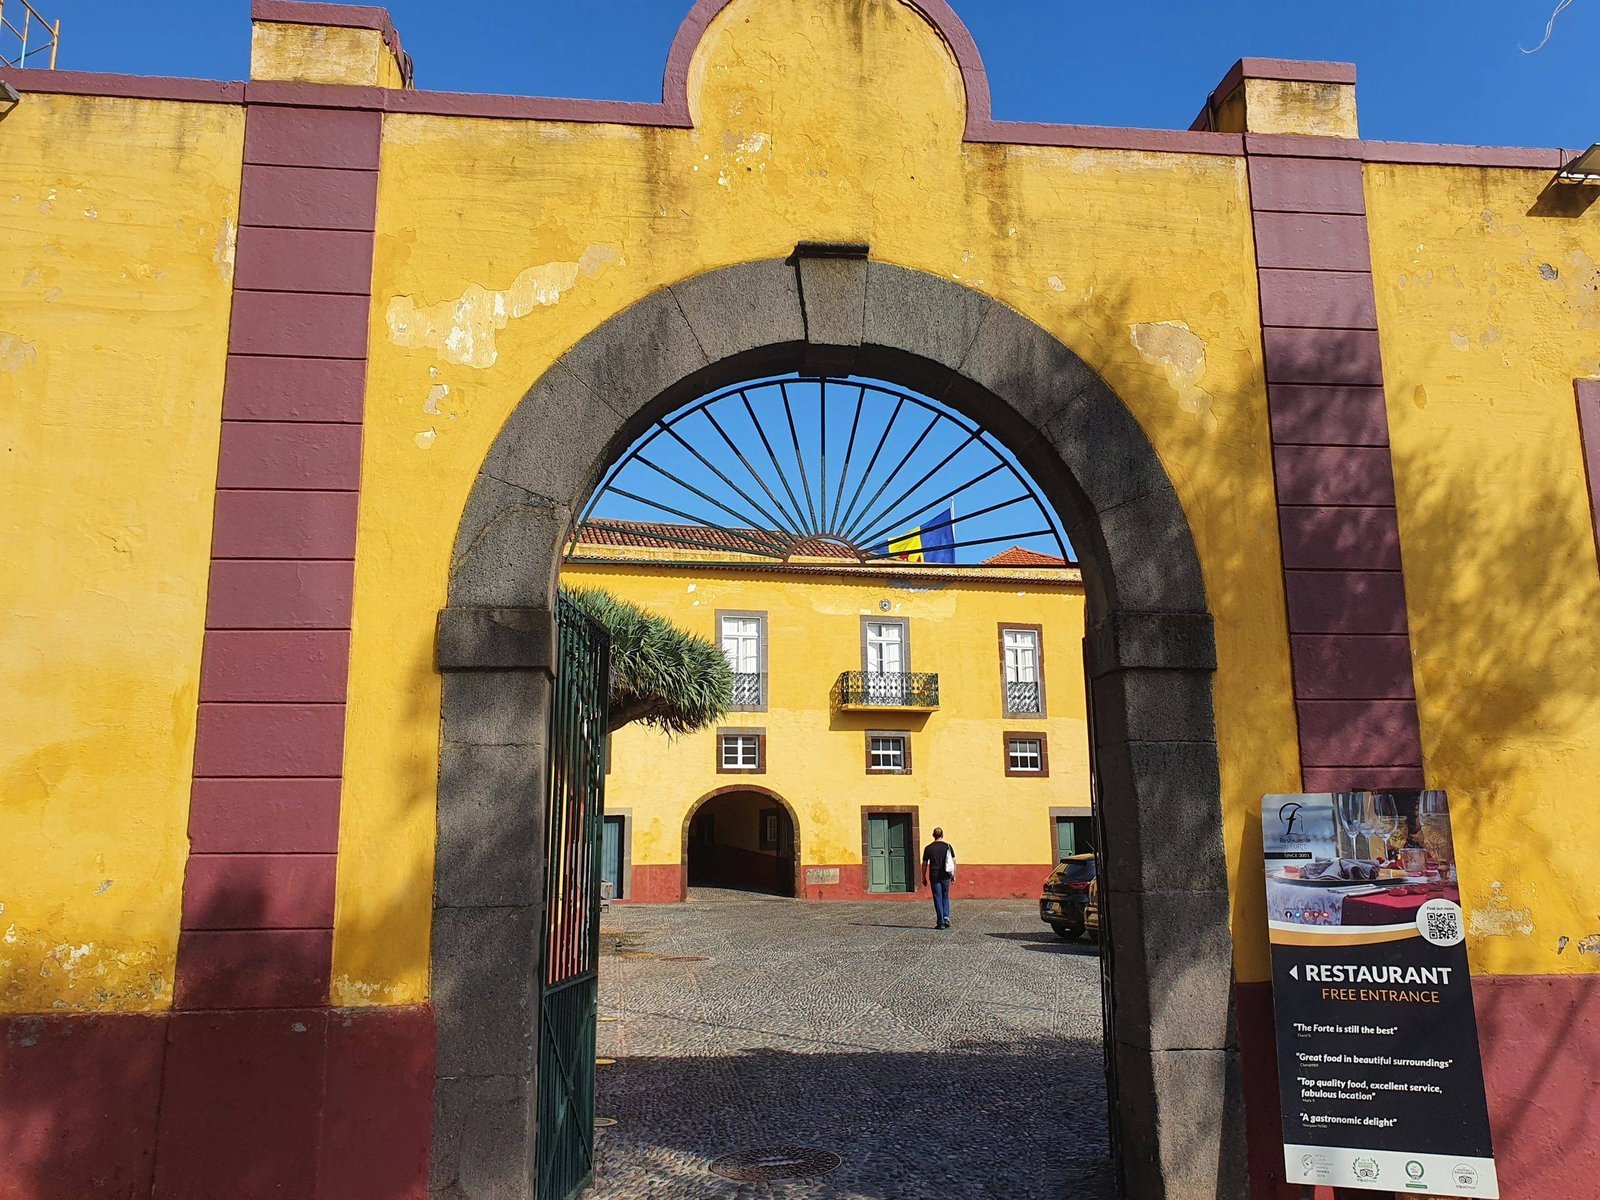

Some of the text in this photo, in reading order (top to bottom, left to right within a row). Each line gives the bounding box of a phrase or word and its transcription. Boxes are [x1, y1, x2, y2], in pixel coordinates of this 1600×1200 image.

[1305, 964, 1452, 985] RESTAURANT
[1322, 988, 1440, 1003] FREE ENTRANCE
[1313, 1023, 1335, 1033] Forte
[1336, 1024, 1343, 1033] is
[1344, 1025, 1360, 1034] still
[1361, 1025, 1375, 1034] the
[1323, 1053, 1342, 1063] food
[1343, 1054, 1352, 1063] in
[1353, 1054, 1392, 1066] beautiful
[1301, 1088, 1337, 1099] fabulous
[1316, 1079, 1346, 1089] quality
[1346, 1079, 1369, 1090] food,
[1370, 1081, 1409, 1091] excellent
[1409, 1083, 1443, 1095] service,
[1310, 1115, 1362, 1125] gastronomic
